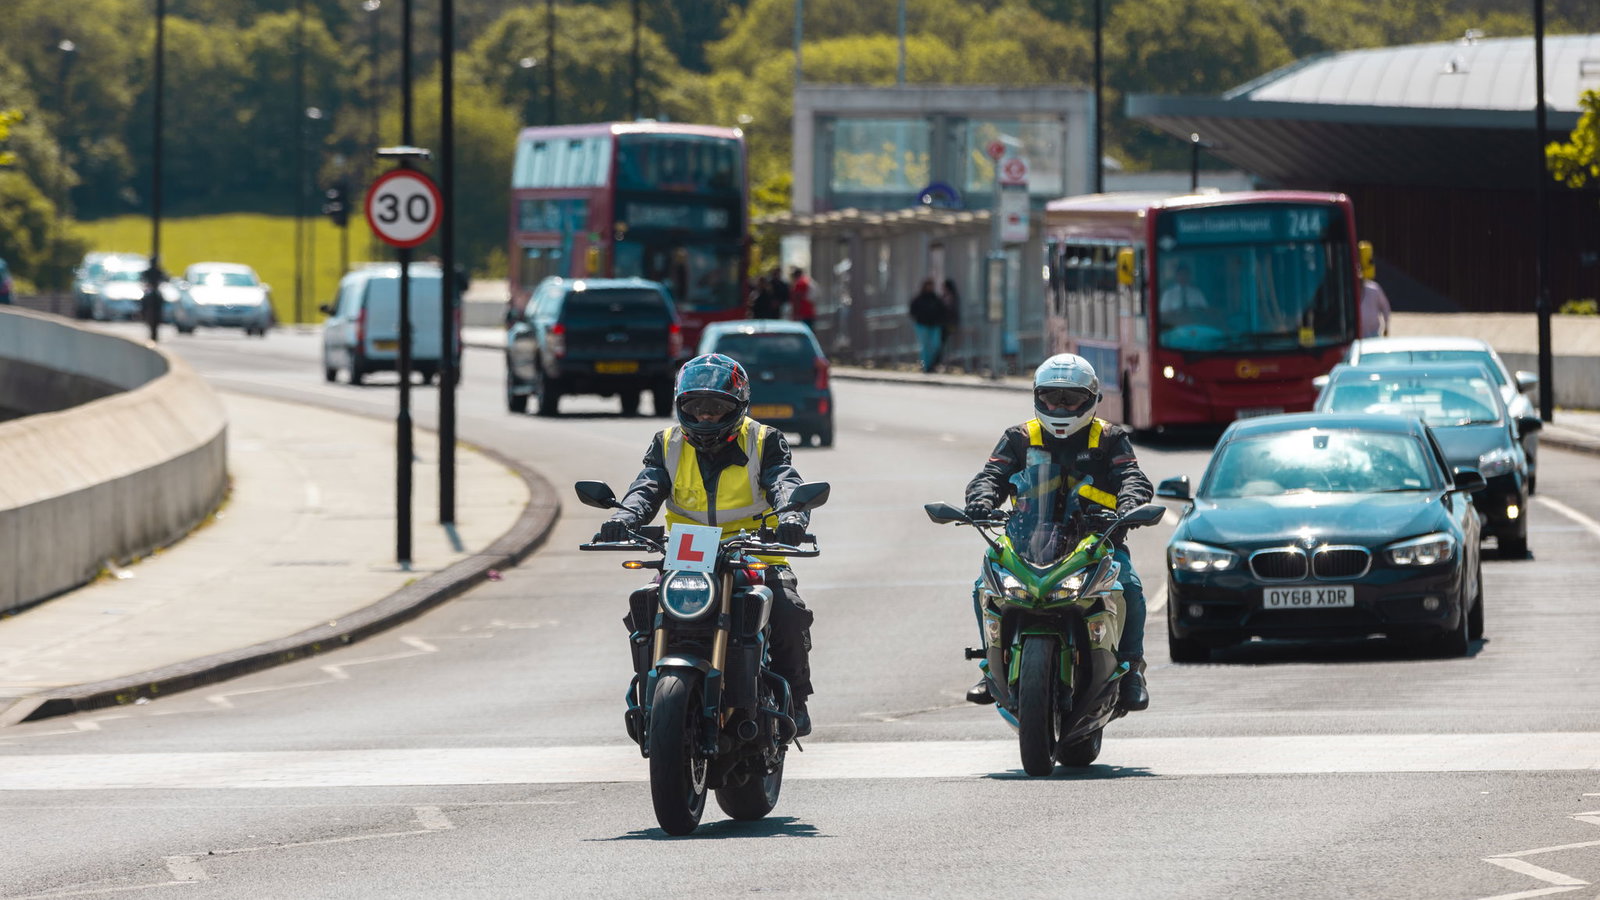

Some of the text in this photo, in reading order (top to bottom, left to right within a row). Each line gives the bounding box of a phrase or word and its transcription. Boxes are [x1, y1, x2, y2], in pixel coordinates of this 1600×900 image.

[378, 193, 429, 224] 30
[1288, 209, 1321, 237] 244
[677, 533, 704, 562] L
[1270, 588, 1347, 606] OY68 XDR
